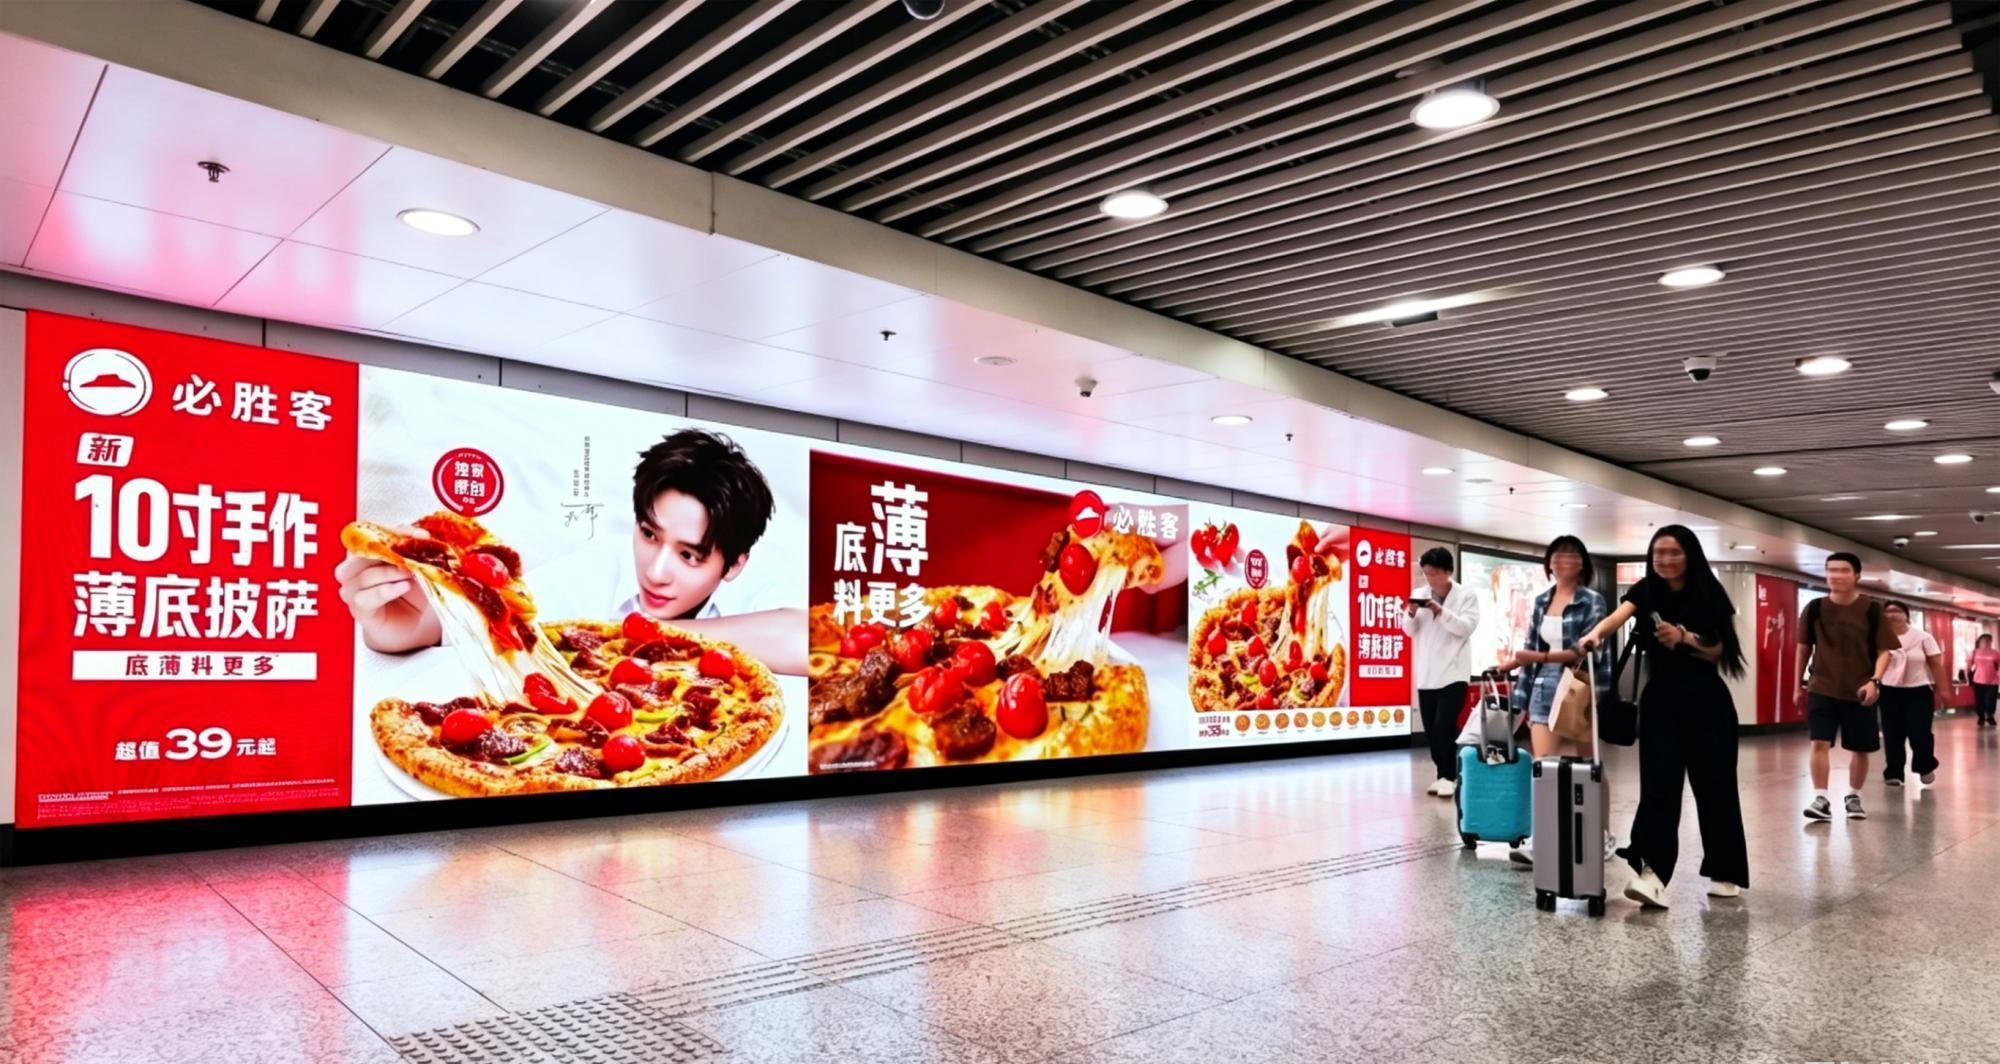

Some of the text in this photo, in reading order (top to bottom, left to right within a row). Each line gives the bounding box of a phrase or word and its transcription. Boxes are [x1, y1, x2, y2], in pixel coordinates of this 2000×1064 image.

[173, 374, 332, 430] 必胜客
[88, 437, 121, 463] 新
[74, 474, 319, 568] 10寸手作
[1113, 504, 1178, 540] 必胜客
[73, 571, 319, 640] 薄底披萨
[834, 579, 931, 629] 料更多
